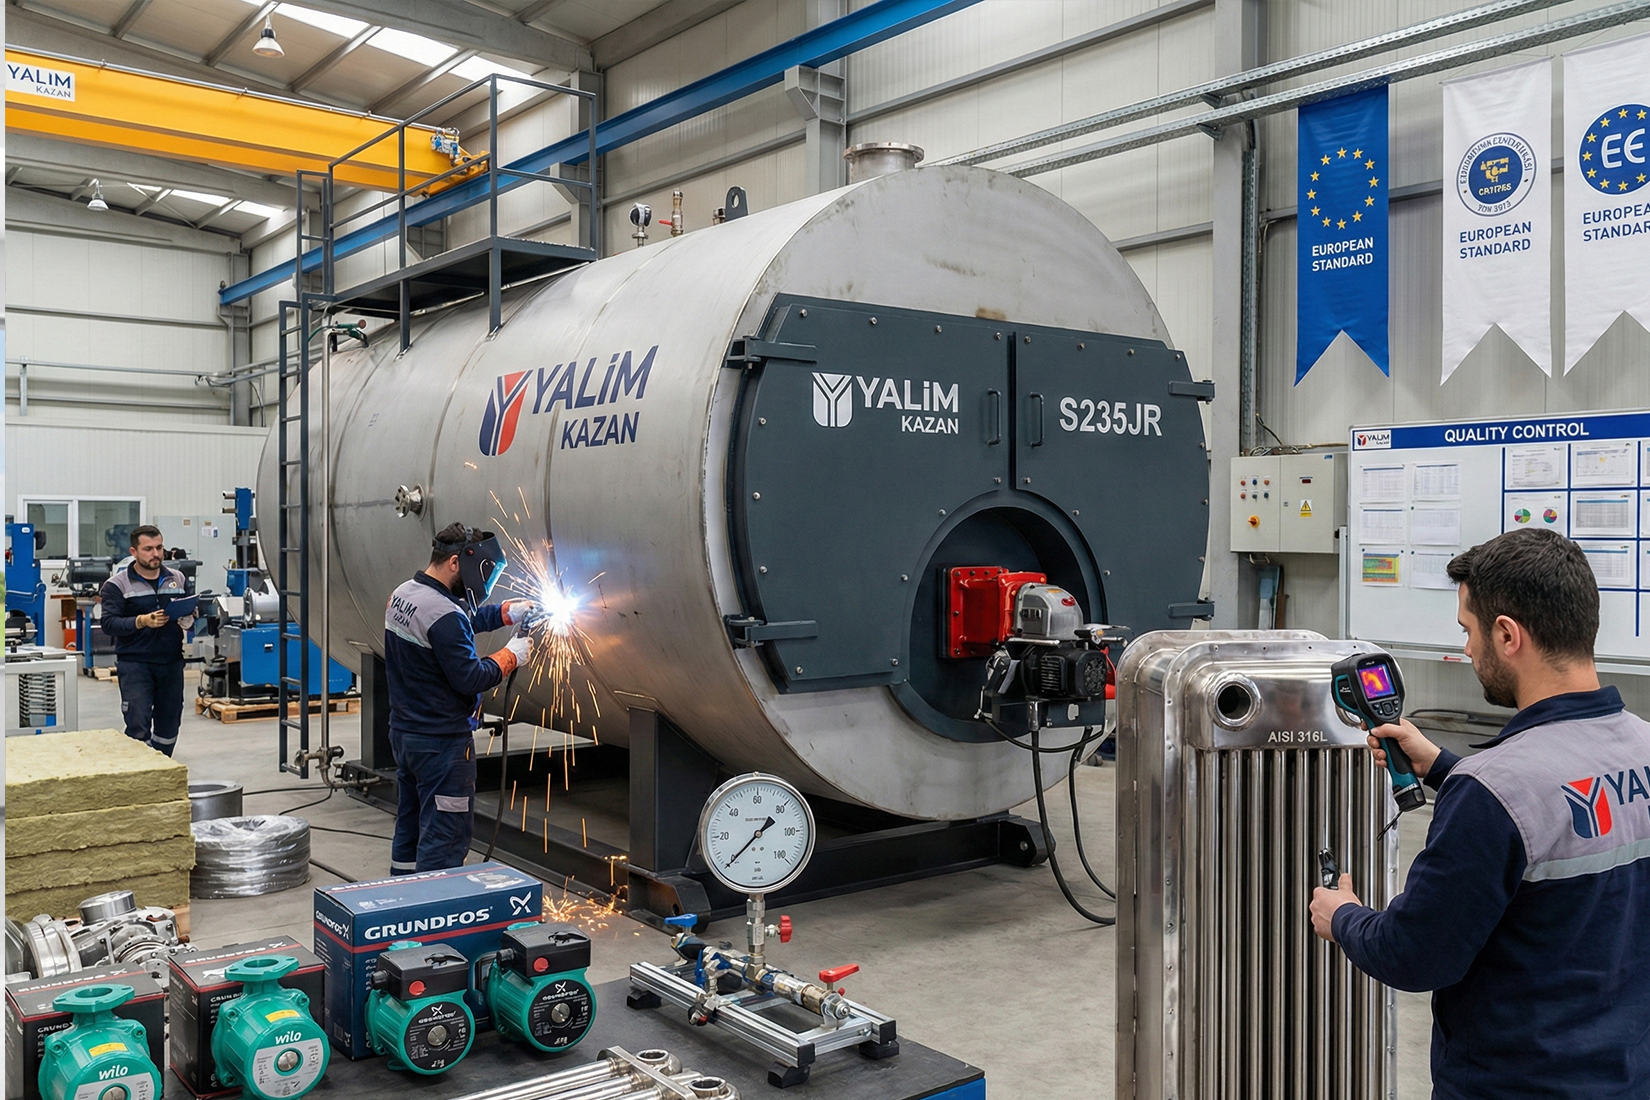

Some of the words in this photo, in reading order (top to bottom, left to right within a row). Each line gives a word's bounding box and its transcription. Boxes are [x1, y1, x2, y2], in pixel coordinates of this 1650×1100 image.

[7, 64, 71, 89] YALIM
[36, 85, 71, 98] KAZAN
[1460, 221, 1532, 243] EUROPEAN
[1312, 237, 1374, 257] EUROPEAN
[1460, 238, 1531, 259] STANDARD
[1312, 252, 1374, 272] STANDARD
[901, 415, 960, 435] KAZAN
[1059, 397, 1163, 437] S235JR
[561, 411, 640, 450] KAZAN
[1444, 426, 1509, 443] QUALITY
[1512, 422, 1590, 439] CONTROL
[391, 595, 418, 618] YALIM
[1267, 730, 1294, 743] AISI
[1297, 730, 1328, 743] 316L
[752, 795, 762, 805] 60
[729, 808, 739, 817] 40
[719, 831, 729, 840] 20
[784, 827, 796, 837] 100
[364, 907, 490, 940] GRUNDFOS
[274, 1030, 302, 1045] wilo
[98, 1064, 129, 1080] wilo
